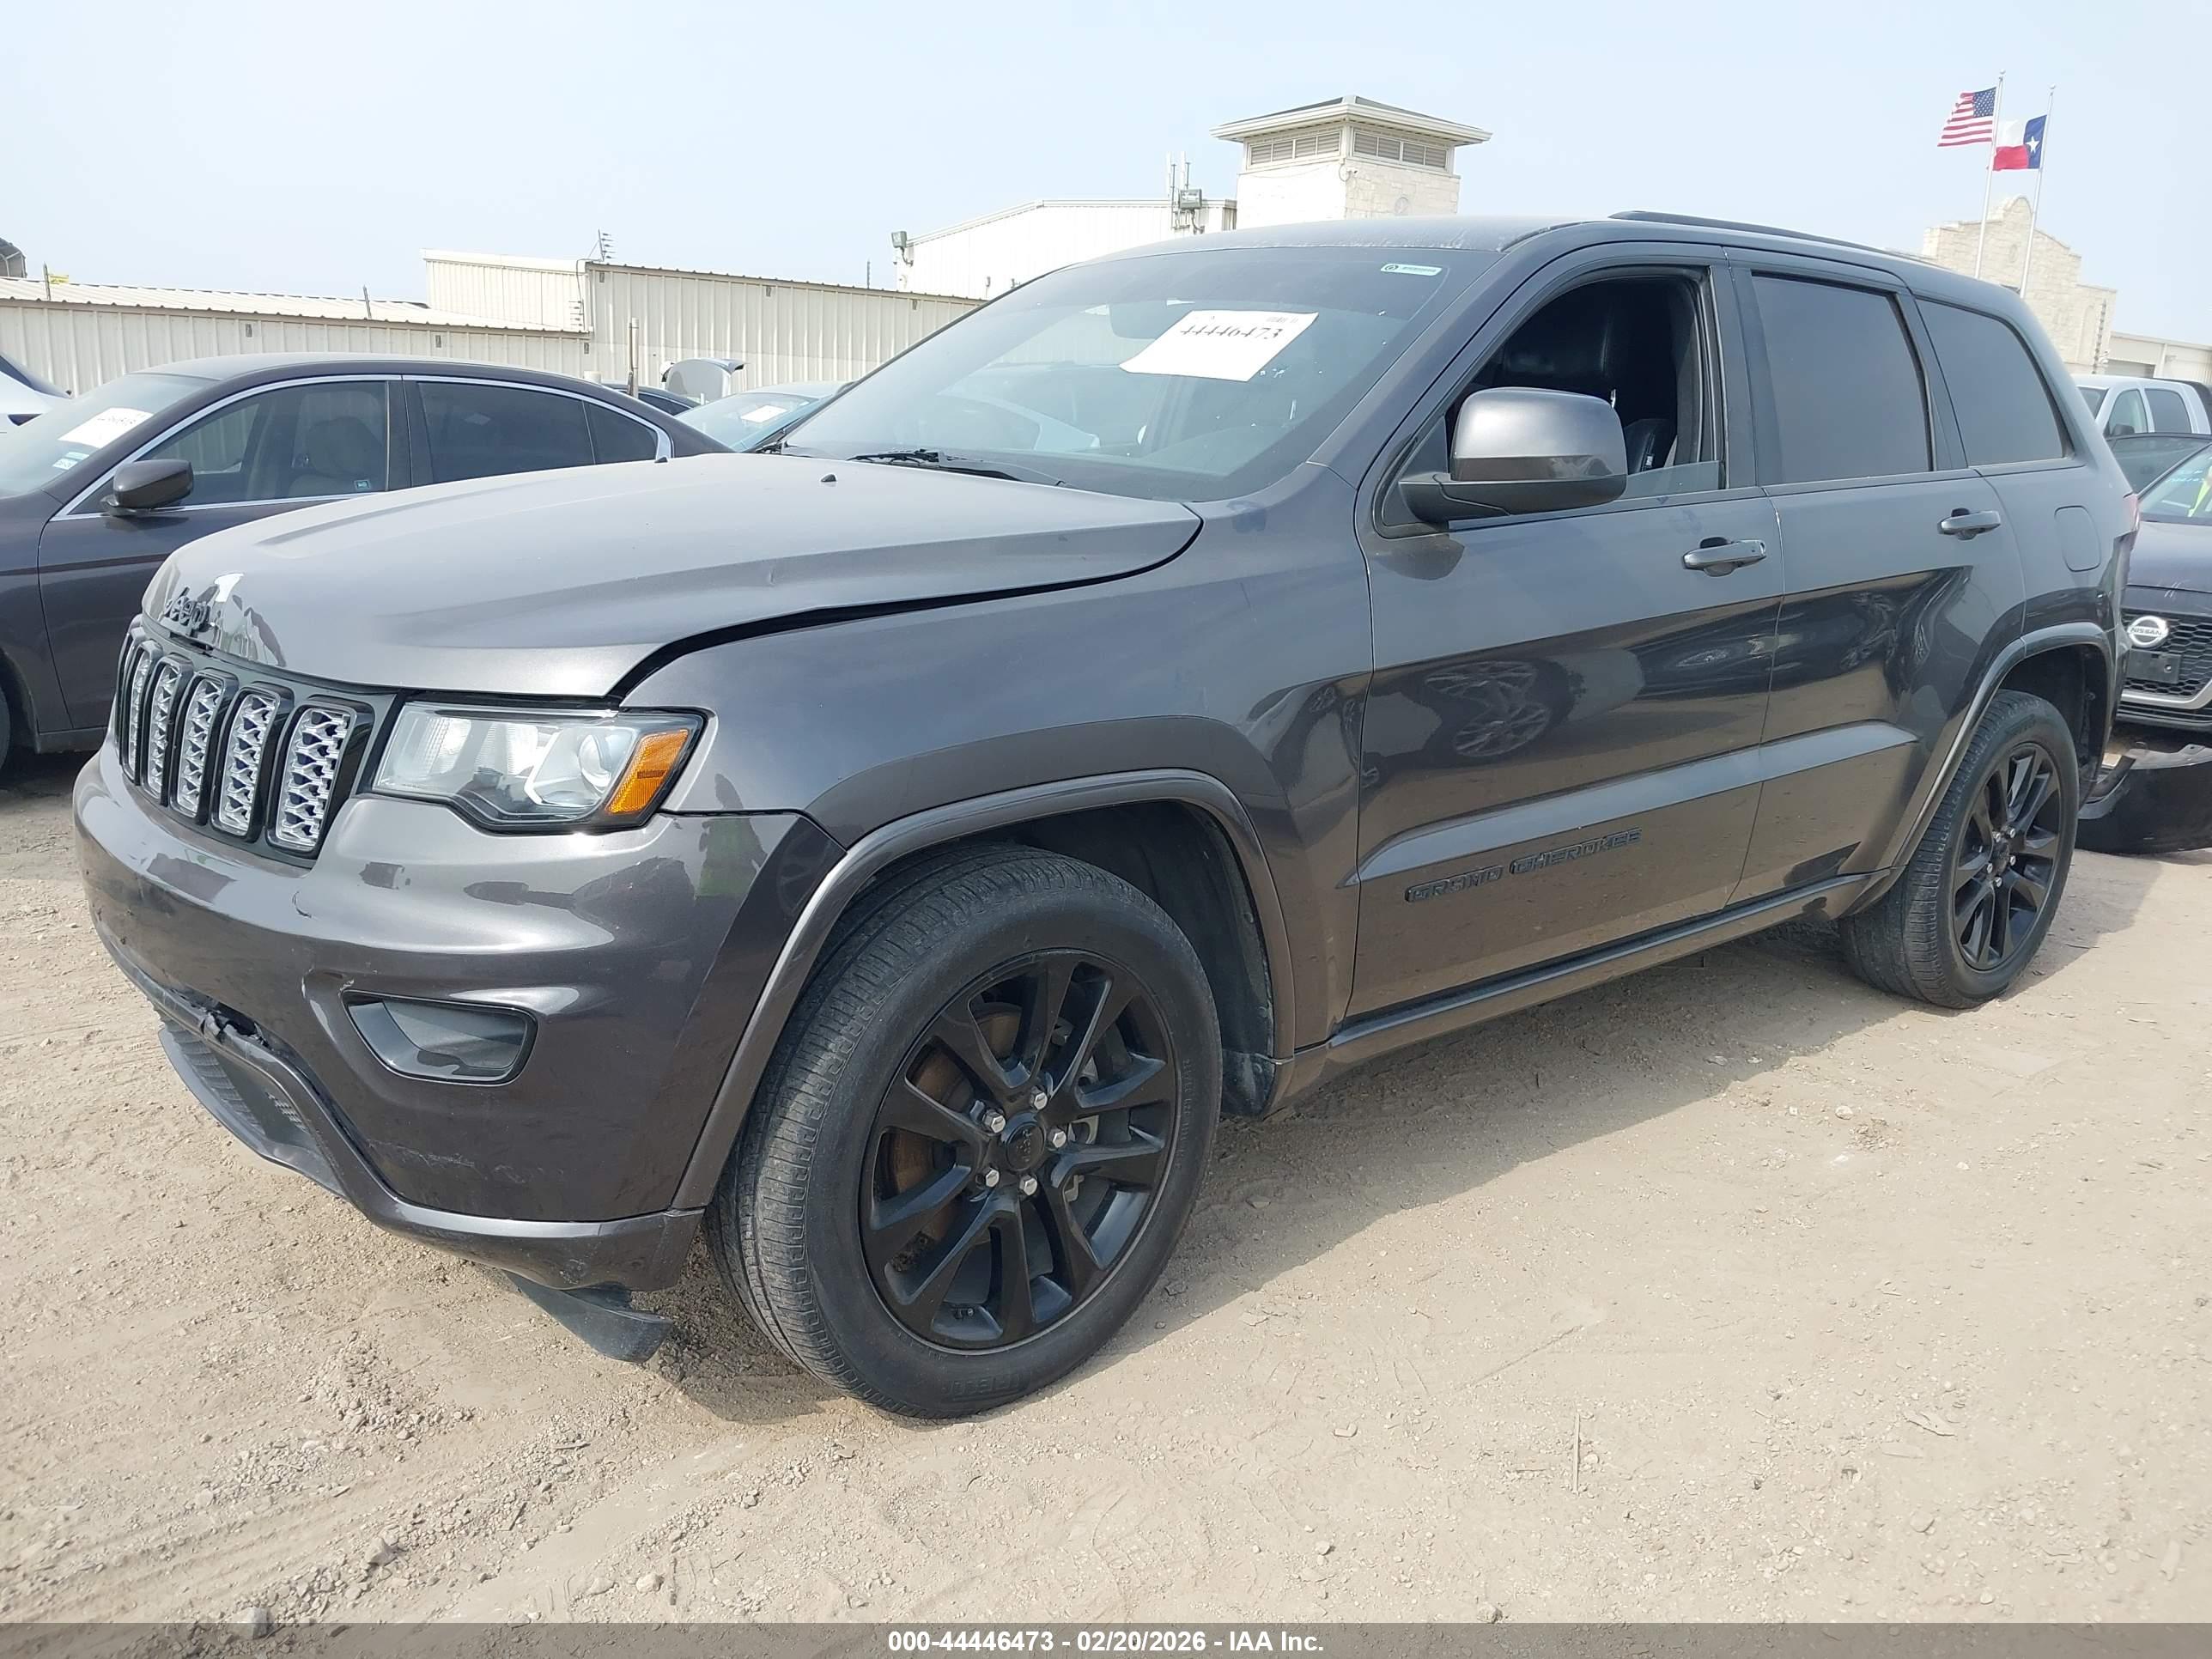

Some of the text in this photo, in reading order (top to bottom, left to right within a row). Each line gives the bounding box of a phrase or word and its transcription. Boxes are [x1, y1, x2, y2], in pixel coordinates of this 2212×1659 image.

[2130, 626, 2162, 636] NISSAN
[1404, 826, 1643, 902] GRAND CHEROKEE
